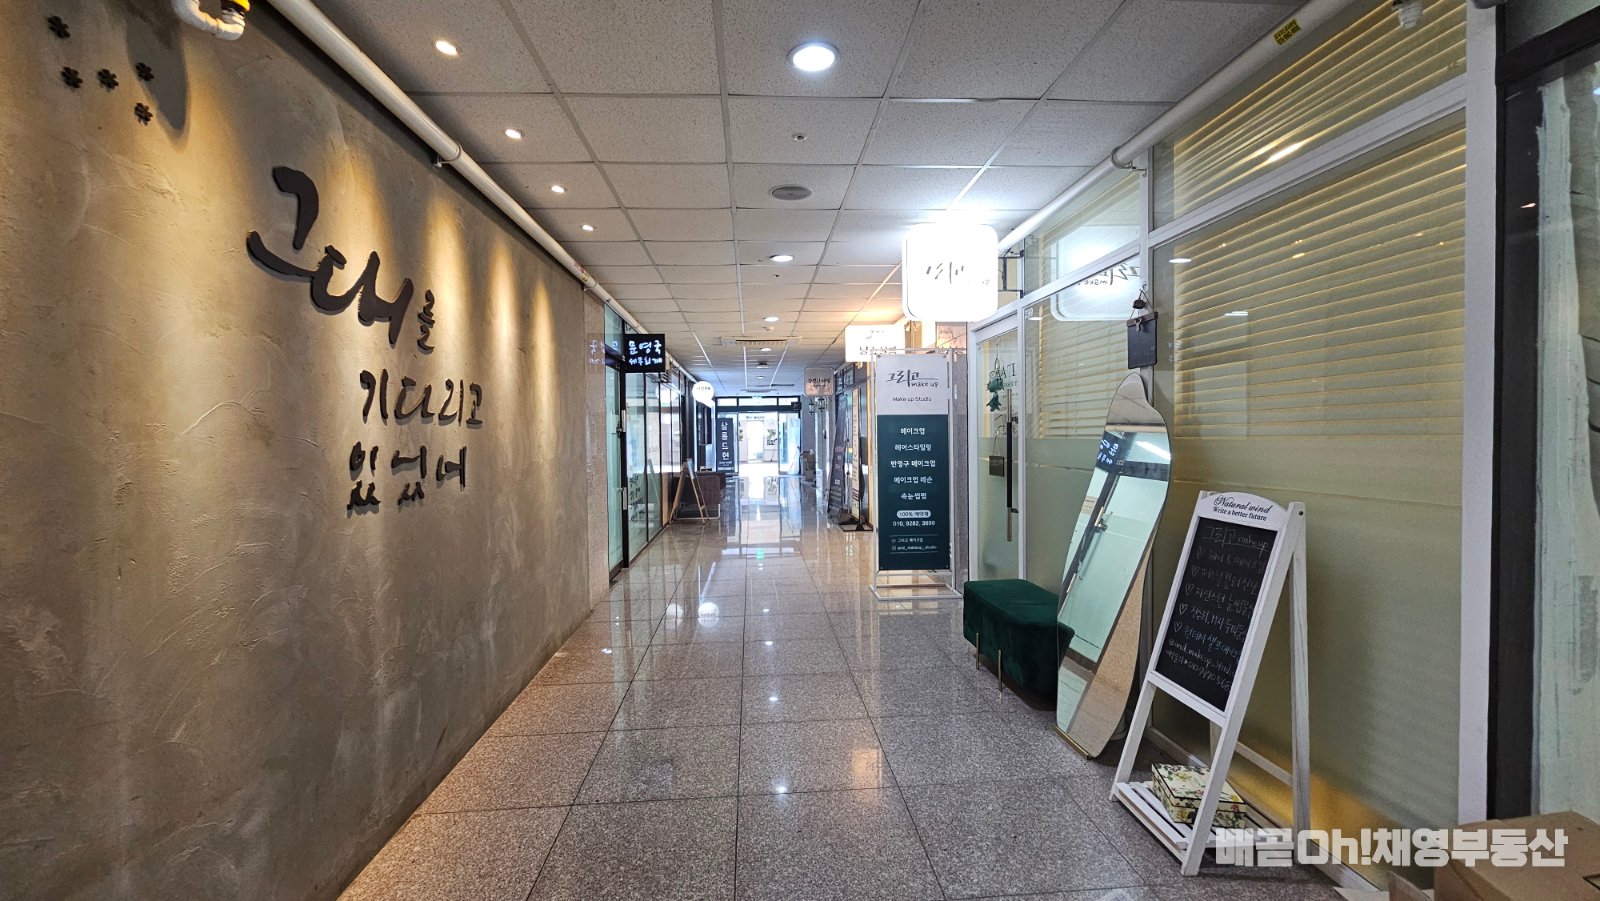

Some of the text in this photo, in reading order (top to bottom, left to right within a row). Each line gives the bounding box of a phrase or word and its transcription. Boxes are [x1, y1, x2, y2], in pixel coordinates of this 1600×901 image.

[246, 166, 436, 354] 그대를
[628, 339, 663, 355] 문영국
[628, 356, 664, 366] 세무회계
[359, 368, 483, 426] 기다리고
[900, 427, 926, 435] 메이크업
[894, 443, 932, 452] 헤어스타일링
[890, 459, 936, 468] 반영구 메이크업
[347, 441, 467, 510] 있었어
[893, 475, 933, 484] 메이크업 레슨
[900, 492, 927, 500] 속눈썹펌
[1213, 495, 1274, 514] Natural wind
[1213, 506, 1227, 515] Write
[1231, 509, 1248, 518] better
[1248, 512, 1267, 521] future
